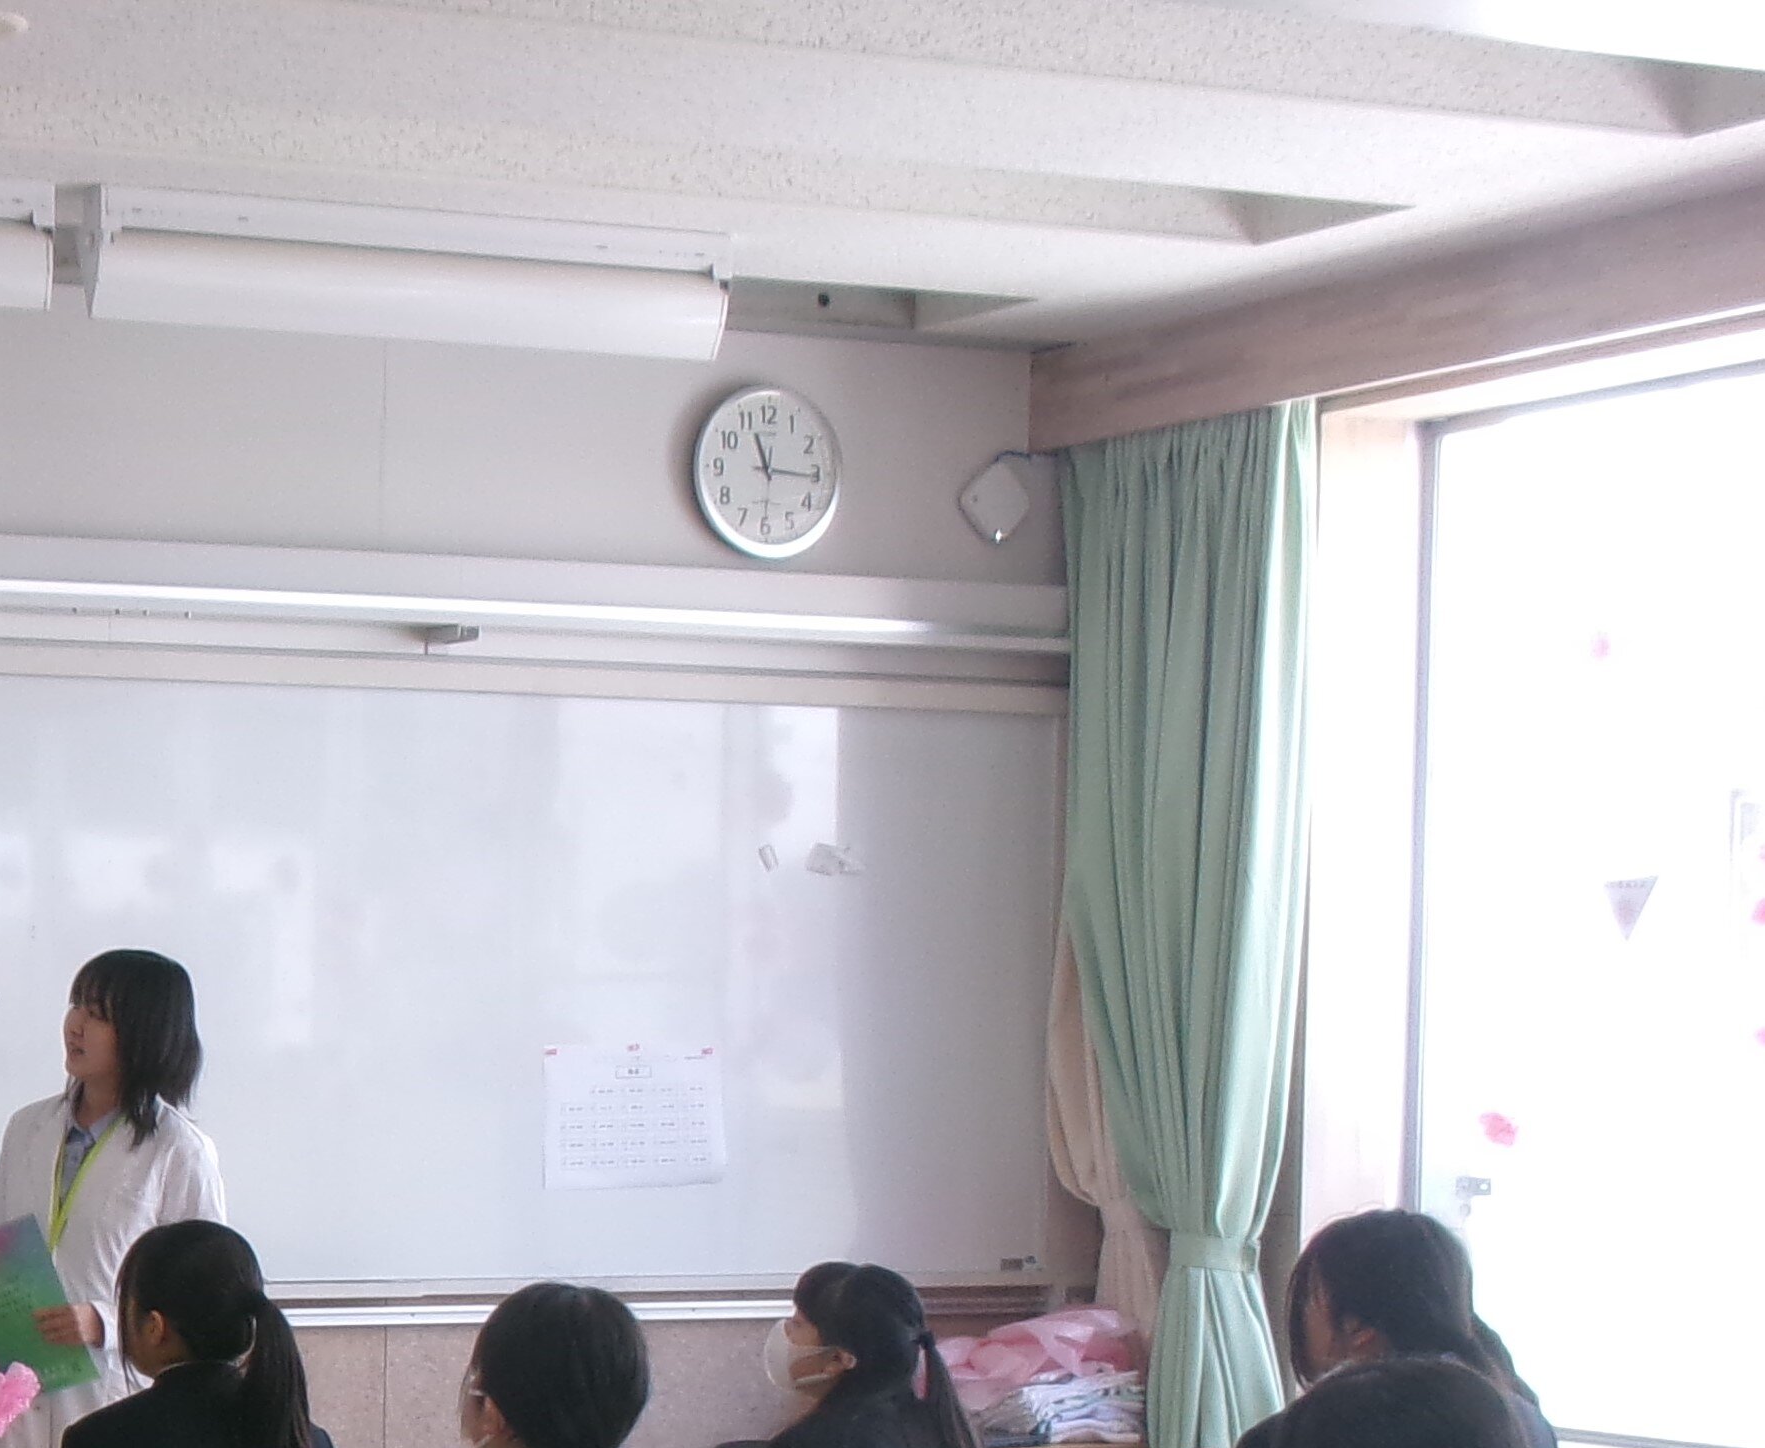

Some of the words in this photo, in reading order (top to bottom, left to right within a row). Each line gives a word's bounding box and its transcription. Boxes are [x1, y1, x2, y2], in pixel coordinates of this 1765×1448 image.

[740, 411, 752, 431] 11
[760, 405, 777, 425] 12
[788, 414, 795, 434] 1
[721, 430, 738, 450] 10
[804, 435, 814, 454] 2
[713, 458, 724, 476] 9
[810, 464, 821, 483] 3
[719, 486, 730, 505] 8
[801, 492, 812, 511] 4
[737, 508, 748, 526] 7
[760, 517, 771, 535] 6
[785, 512, 794, 530] 5
